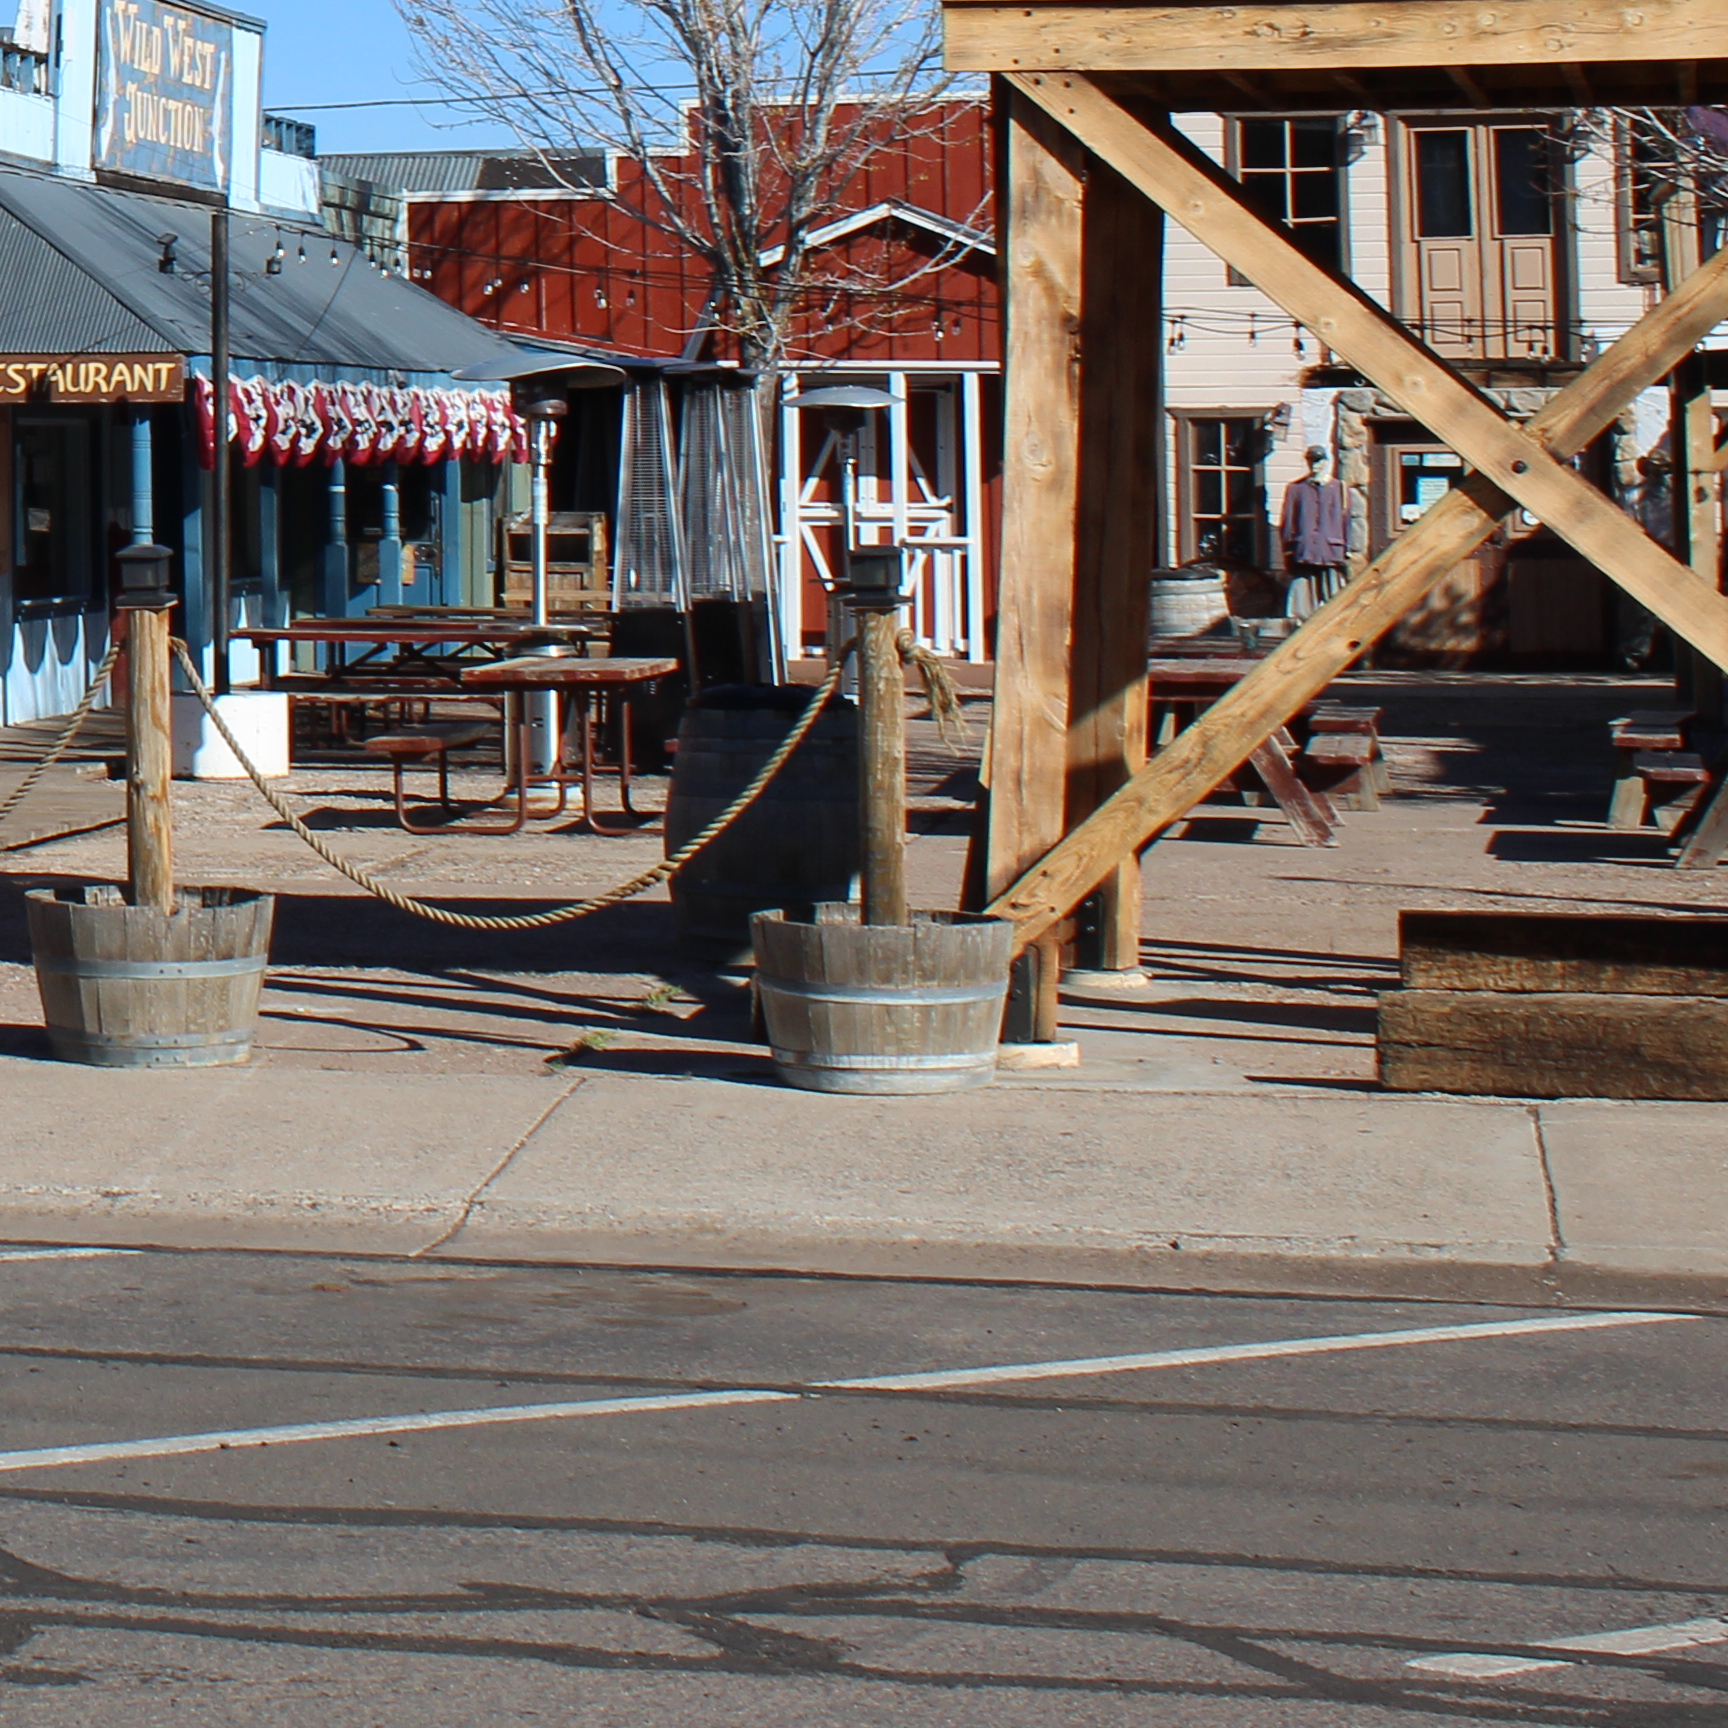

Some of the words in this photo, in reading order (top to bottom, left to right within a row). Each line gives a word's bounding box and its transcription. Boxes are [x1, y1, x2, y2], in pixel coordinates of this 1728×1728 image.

[114, 0, 162, 75] WILD
[163, 15, 216, 90] WEST
[123, 80, 205, 153] JUNCTION
